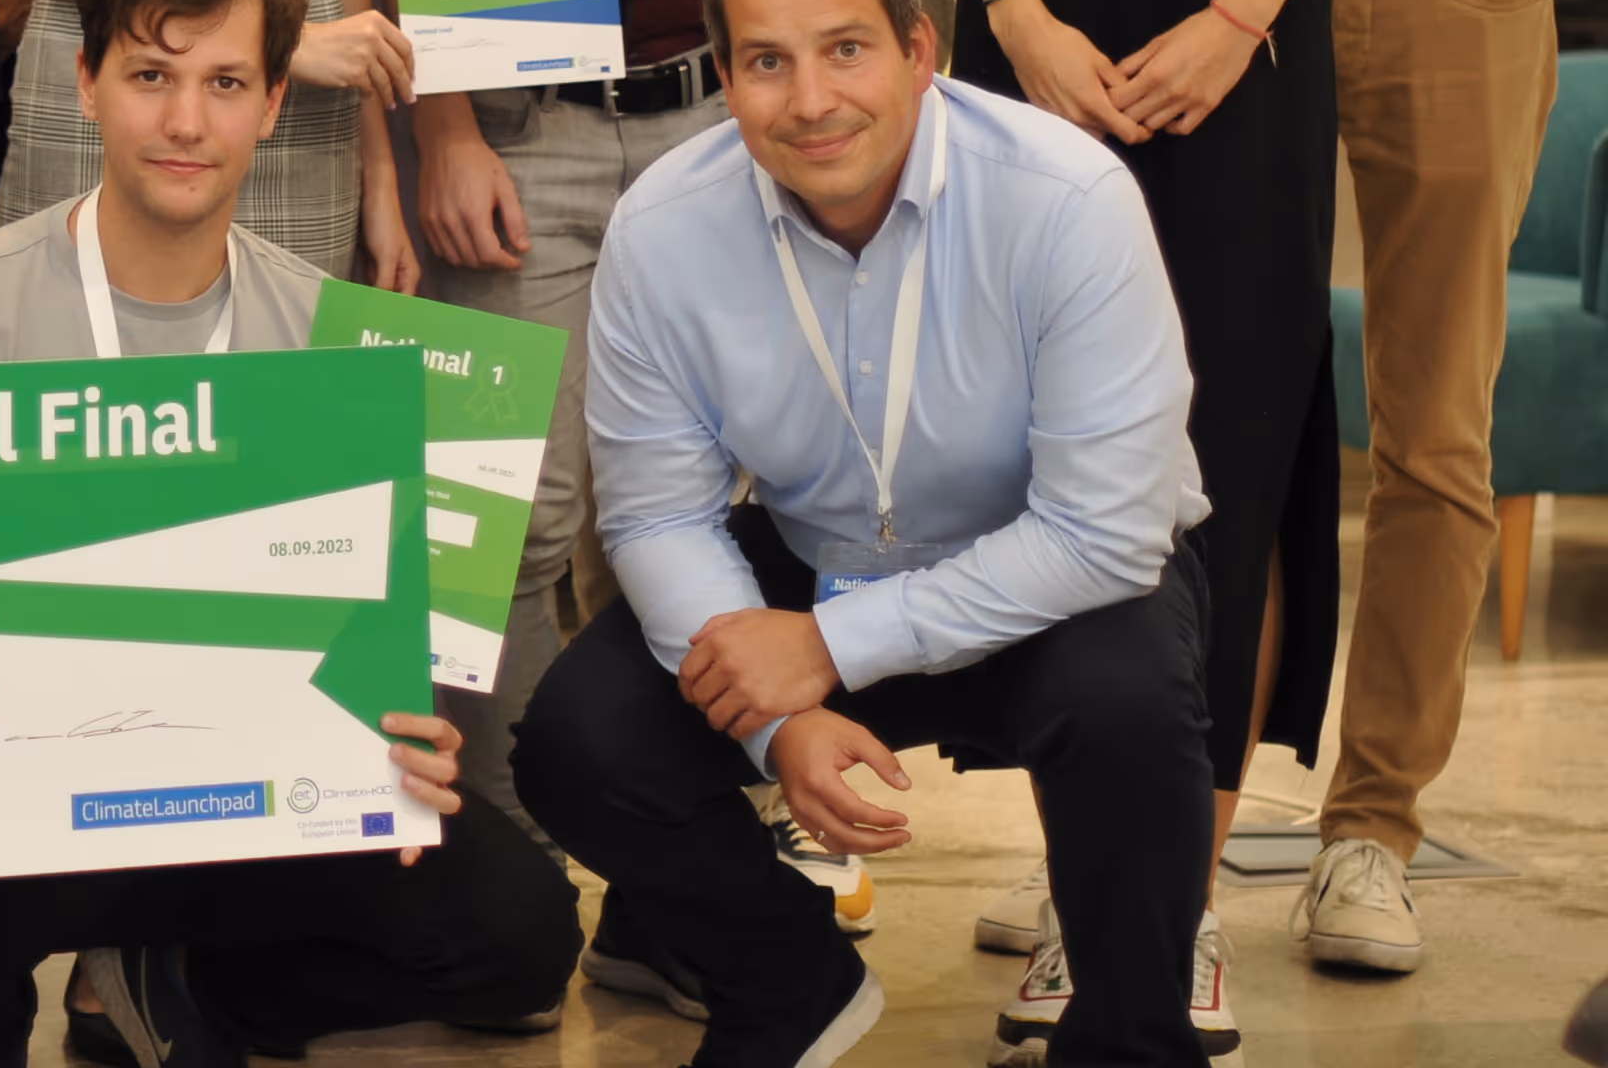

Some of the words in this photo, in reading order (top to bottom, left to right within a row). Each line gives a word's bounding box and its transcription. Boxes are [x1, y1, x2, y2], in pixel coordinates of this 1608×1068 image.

[492, 365, 503, 385] 1
[40, 381, 217, 461] Final
[268, 538, 354, 558] 08.09.2023
[835, 578, 872, 592] Natio
[82, 791, 255, 822] ClimateLaunchpad
